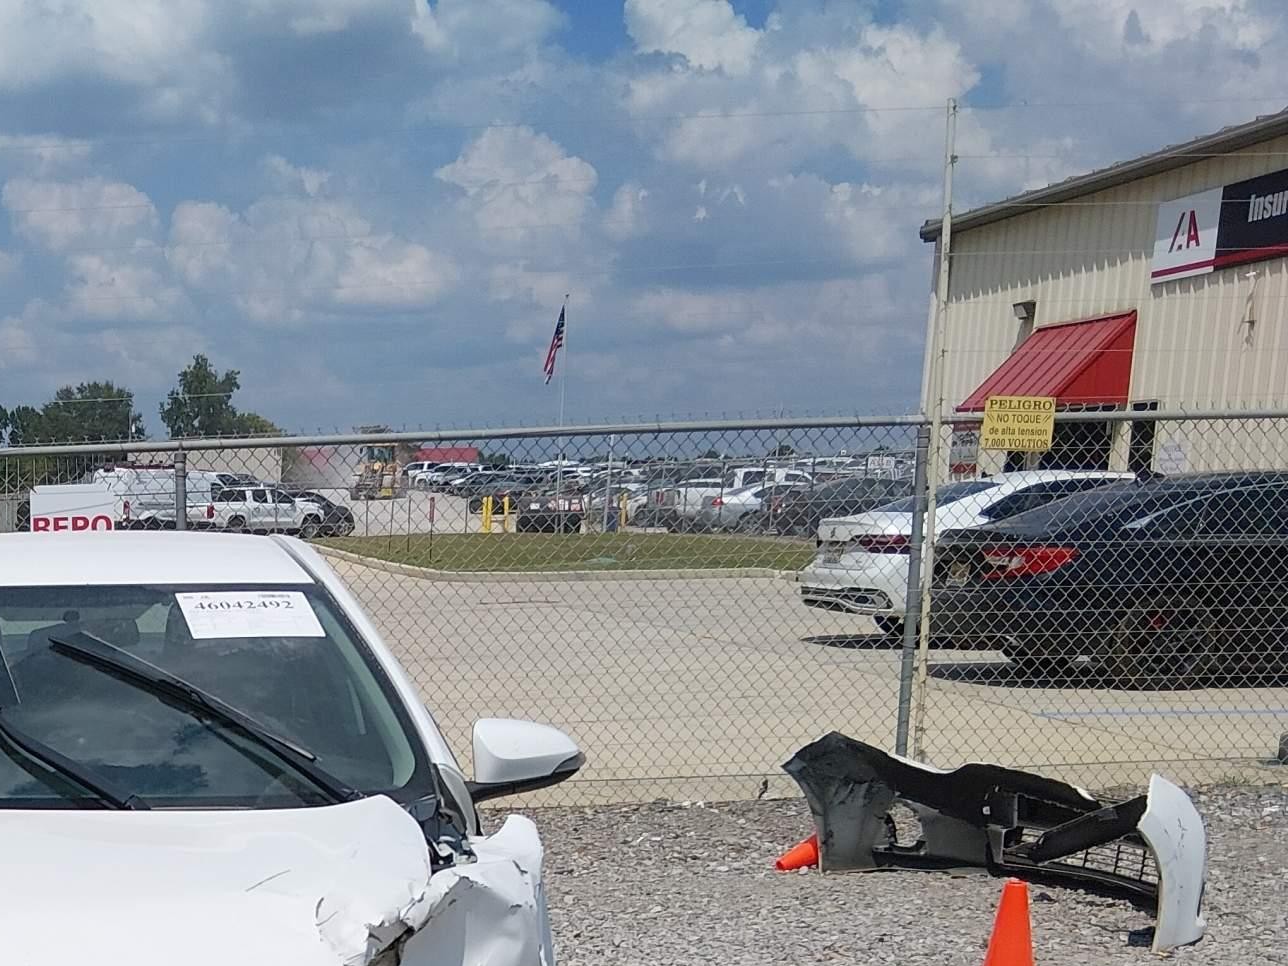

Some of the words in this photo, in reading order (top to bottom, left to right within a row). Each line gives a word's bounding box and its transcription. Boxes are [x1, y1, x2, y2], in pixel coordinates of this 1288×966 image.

[989, 399, 1053, 411] PELIGRO
[996, 413, 1009, 424] NO
[1012, 414, 1041, 424] TOQUE
[988, 427, 999, 436] de
[1001, 427, 1016, 436] alta
[1008, 438, 1049, 449] VOLTIOS
[194, 600, 294, 610] 46042492
